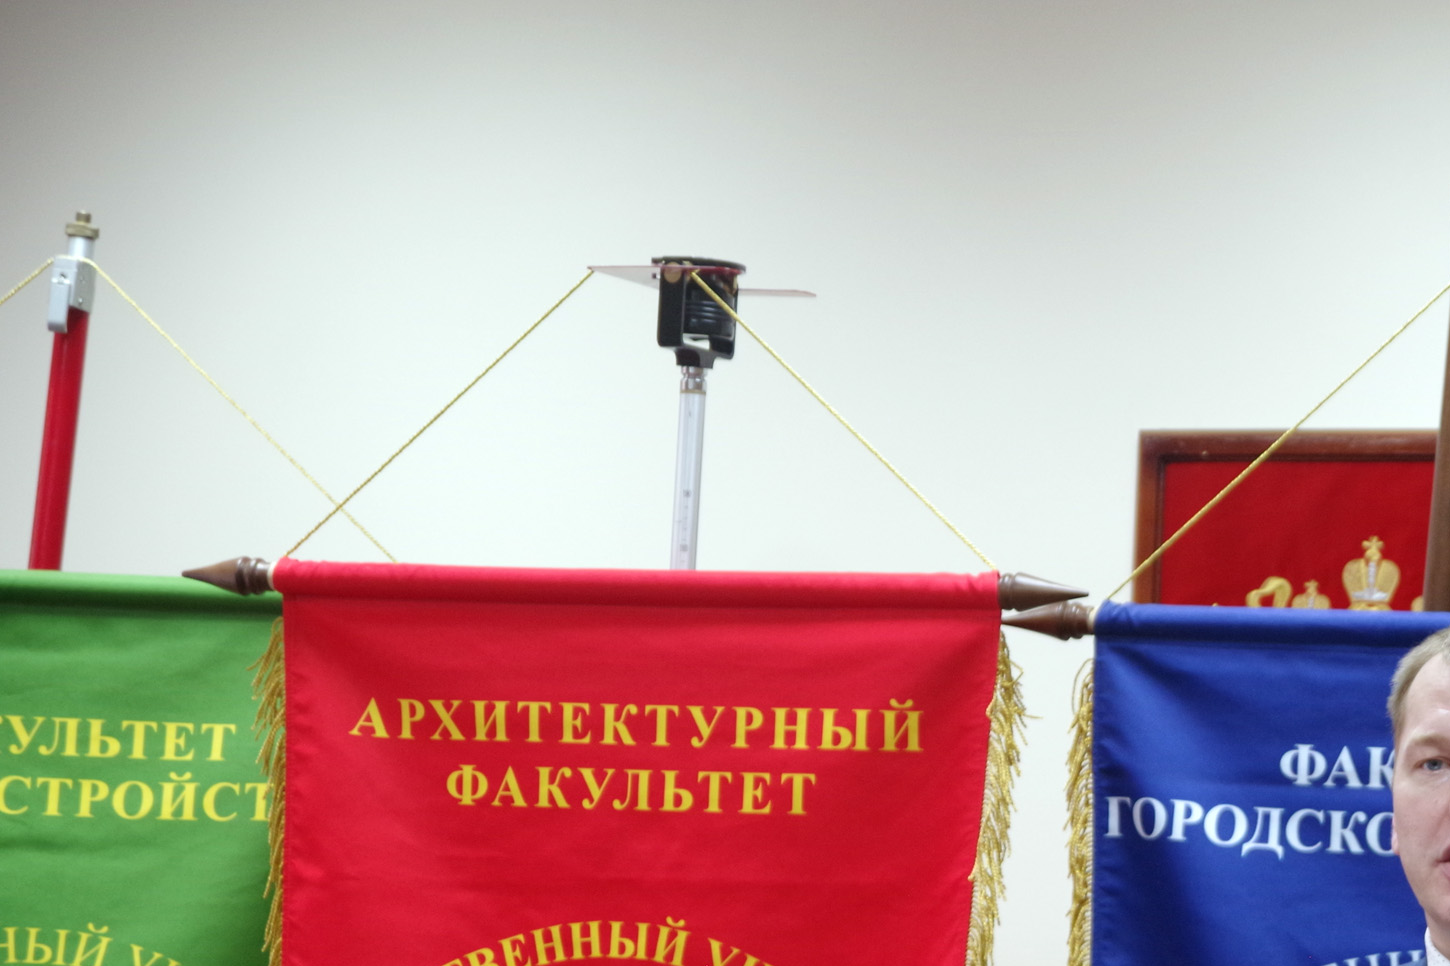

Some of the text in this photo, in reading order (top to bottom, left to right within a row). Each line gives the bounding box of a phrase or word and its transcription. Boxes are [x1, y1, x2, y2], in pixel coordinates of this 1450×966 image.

[0, 714, 237, 762] УЛЬТЕТ
[349, 697, 925, 753] АРХИТЕКТУРНЫЙ
[446, 764, 817, 816] ФАКУЛЬТЕТ
